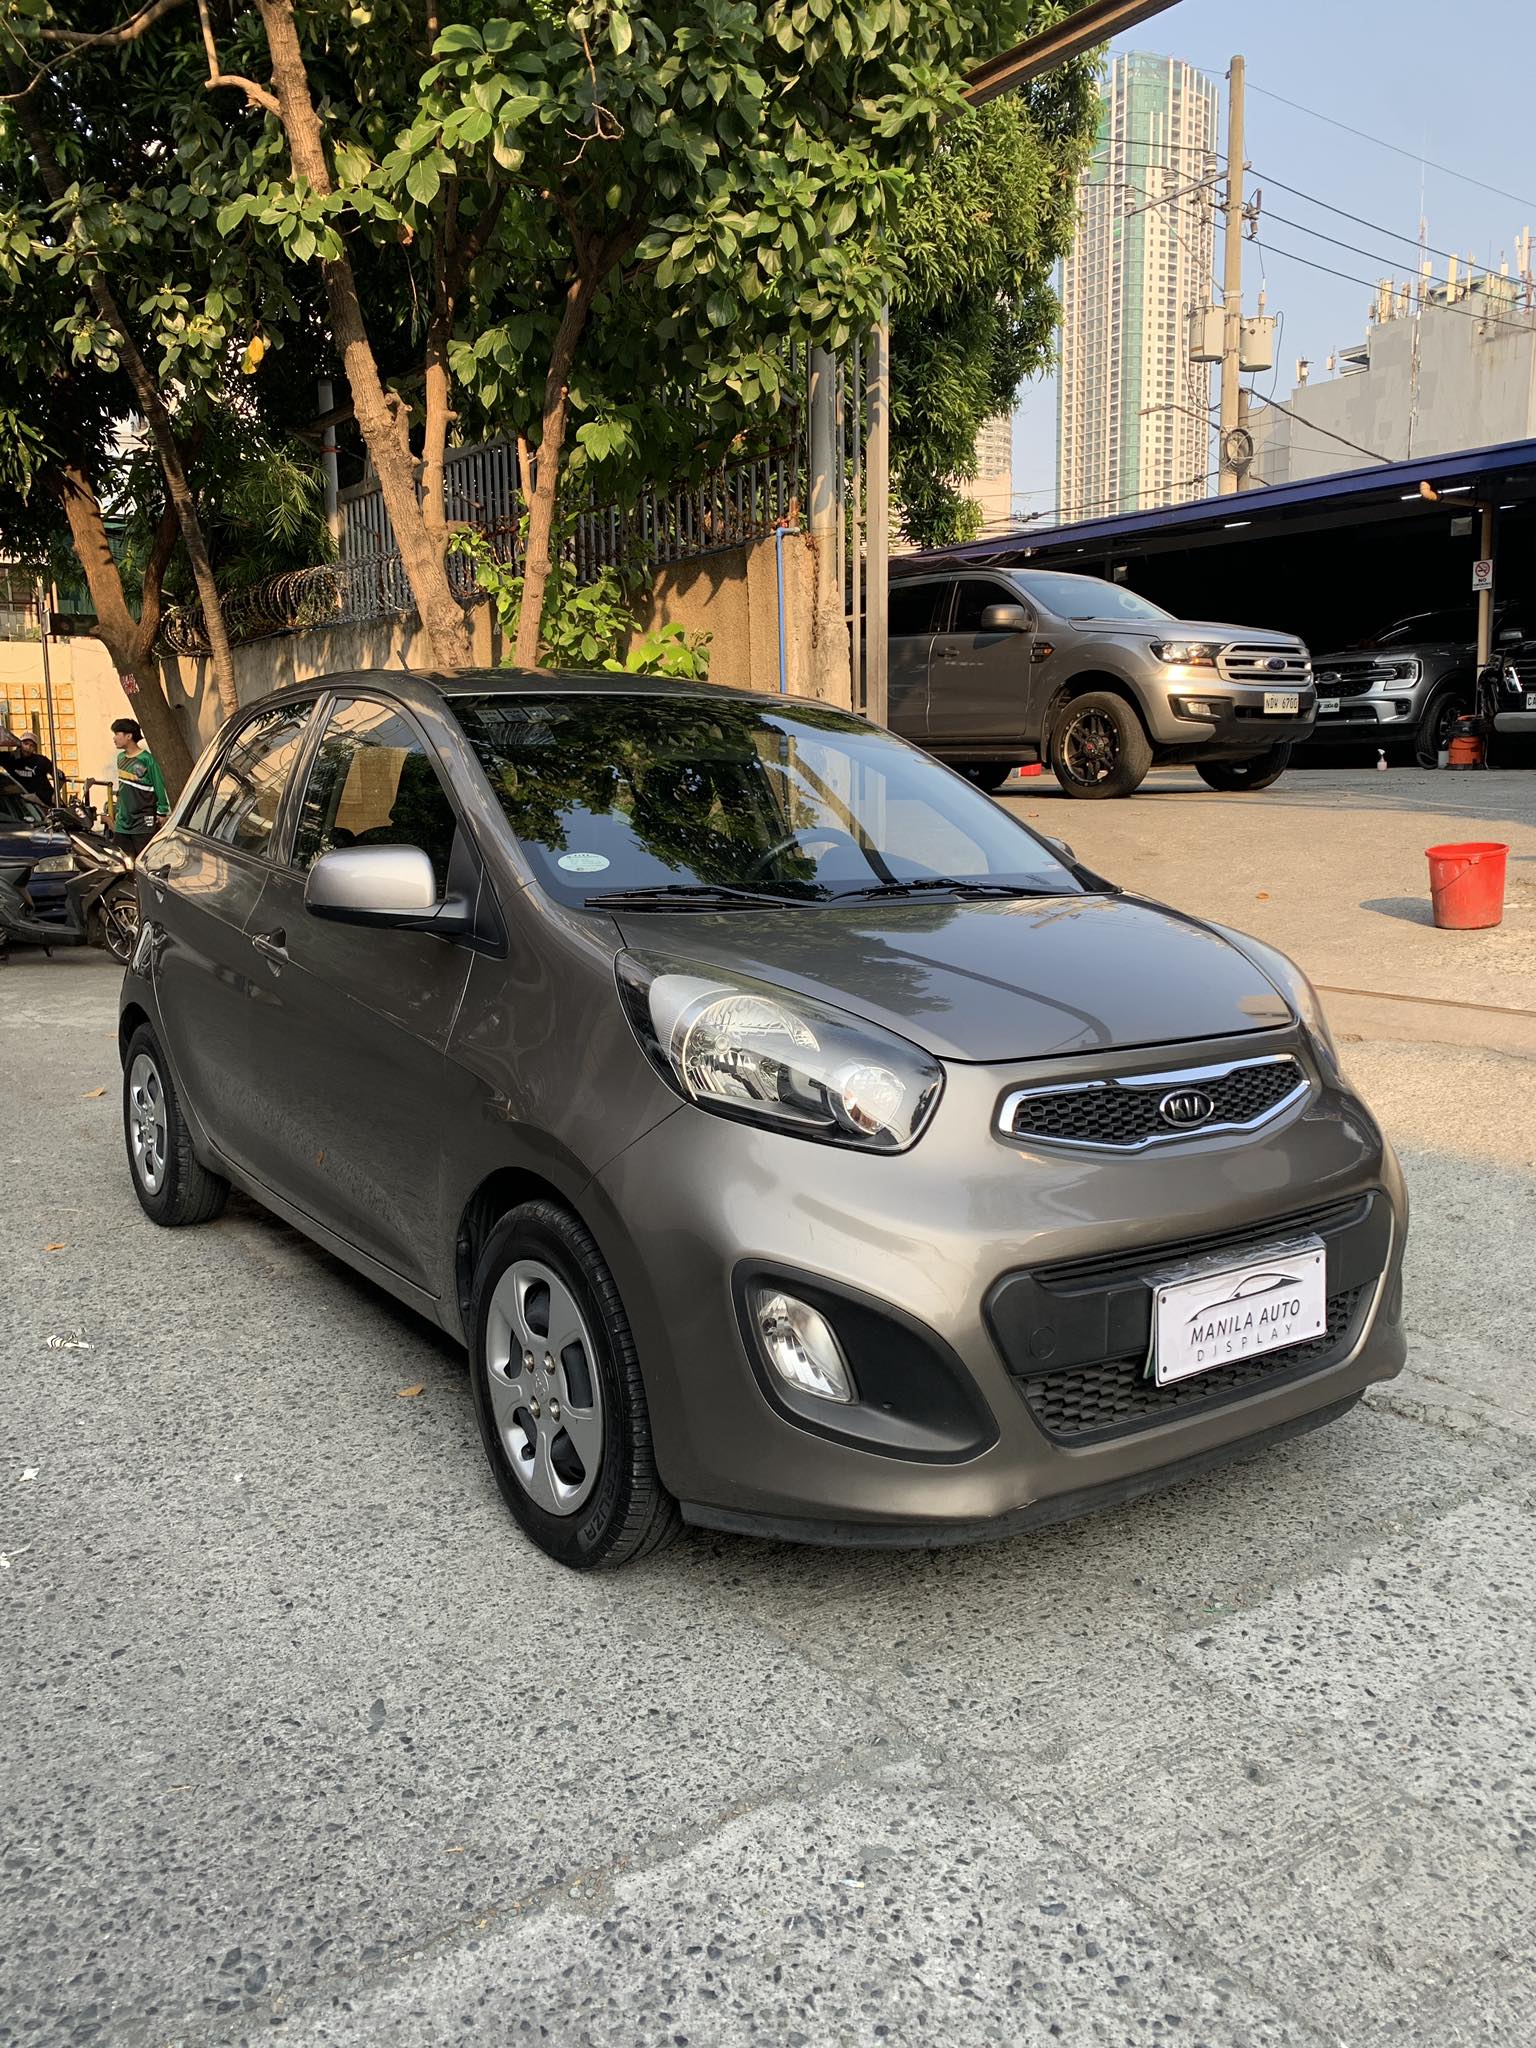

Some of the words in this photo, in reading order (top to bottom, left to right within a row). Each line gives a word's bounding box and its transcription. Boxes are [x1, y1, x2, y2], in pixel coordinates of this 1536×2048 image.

[1169, 1096, 1208, 1120] KIA
[1190, 1311, 1253, 1346] MANILA
[1259, 1299, 1301, 1326] AUTO
[1196, 1323, 1294, 1362] DISPLAY
